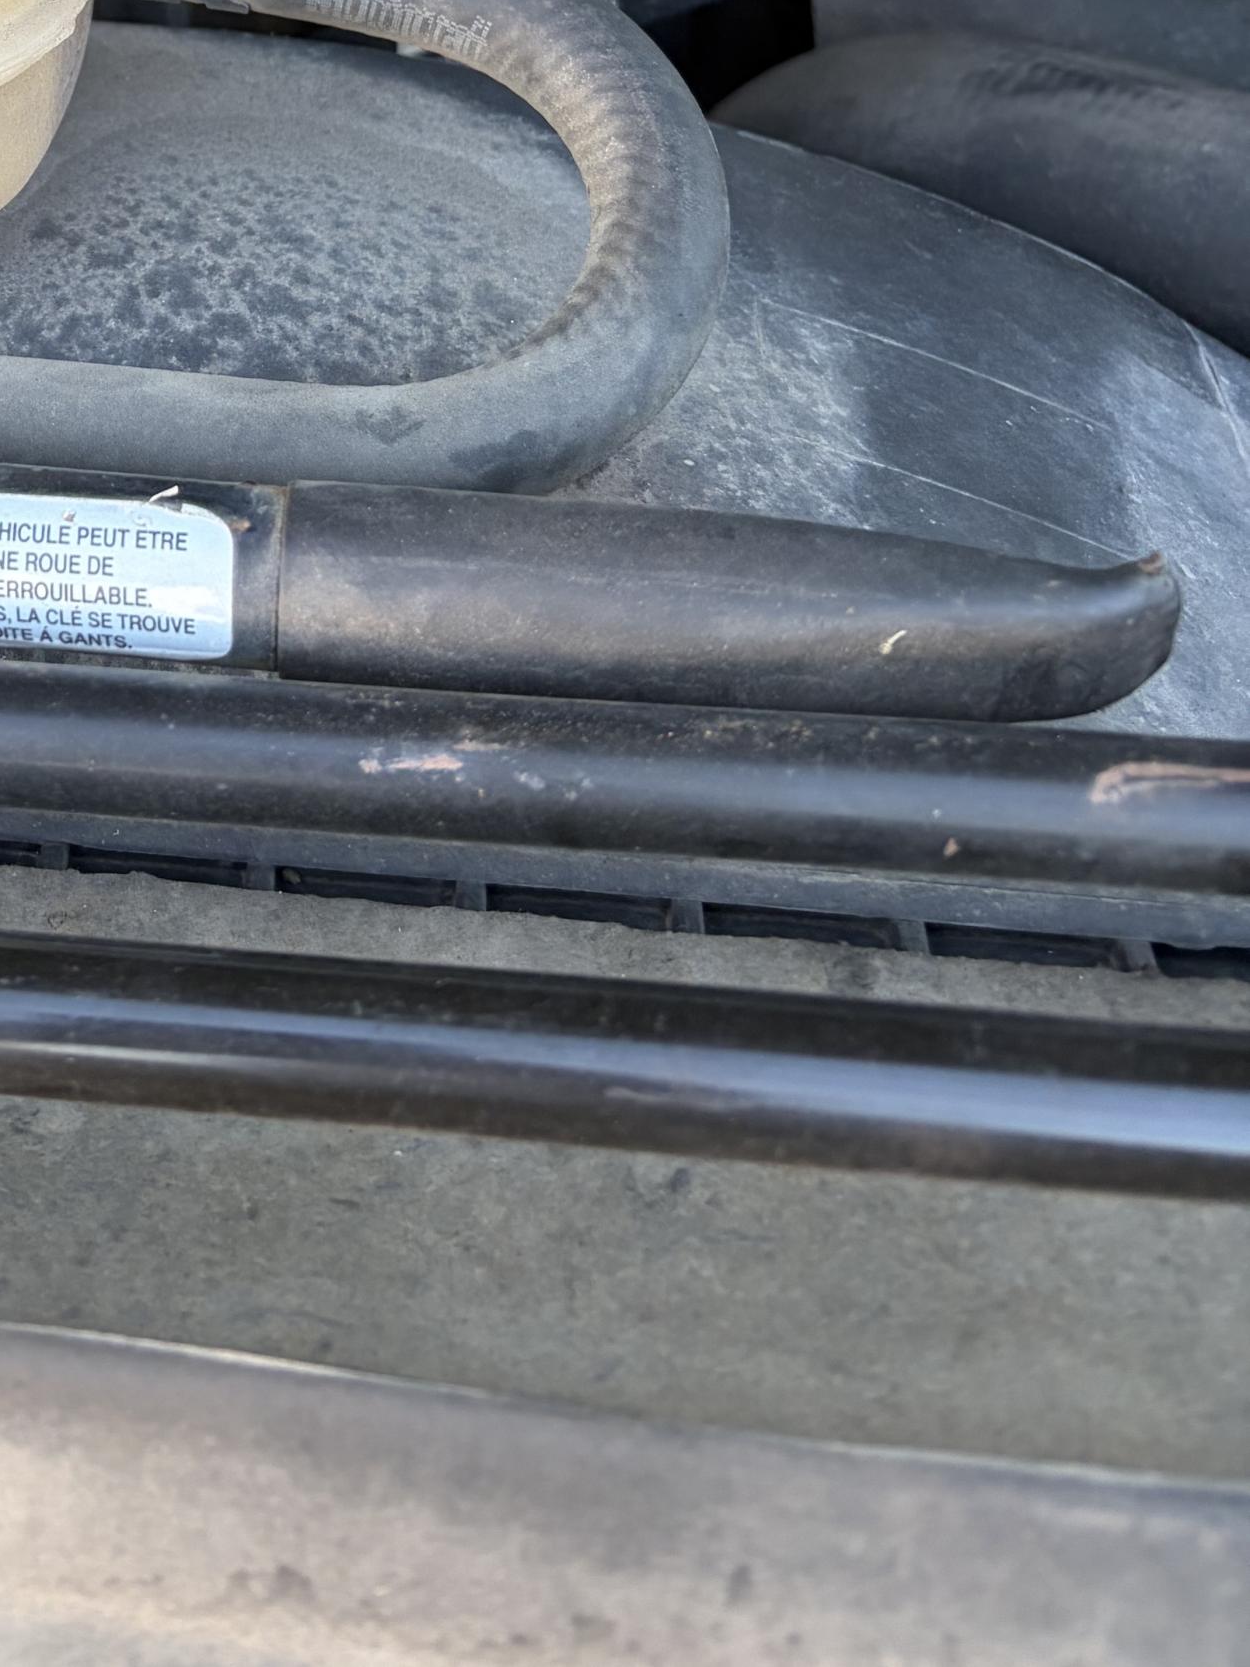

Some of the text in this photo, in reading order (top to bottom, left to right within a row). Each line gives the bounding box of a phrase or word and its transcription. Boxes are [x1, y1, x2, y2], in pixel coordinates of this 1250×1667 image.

[76, 526, 129, 548] PEUT
[25, 552, 81, 574] ROUE
[87, 556, 114, 577] DE
[16, 606, 41, 625] LA
[45, 606, 82, 627] CLÉ
[88, 611, 113, 630] SE
[117, 613, 196, 635] TROUVE
[57, 630, 133, 649] GANTS.
